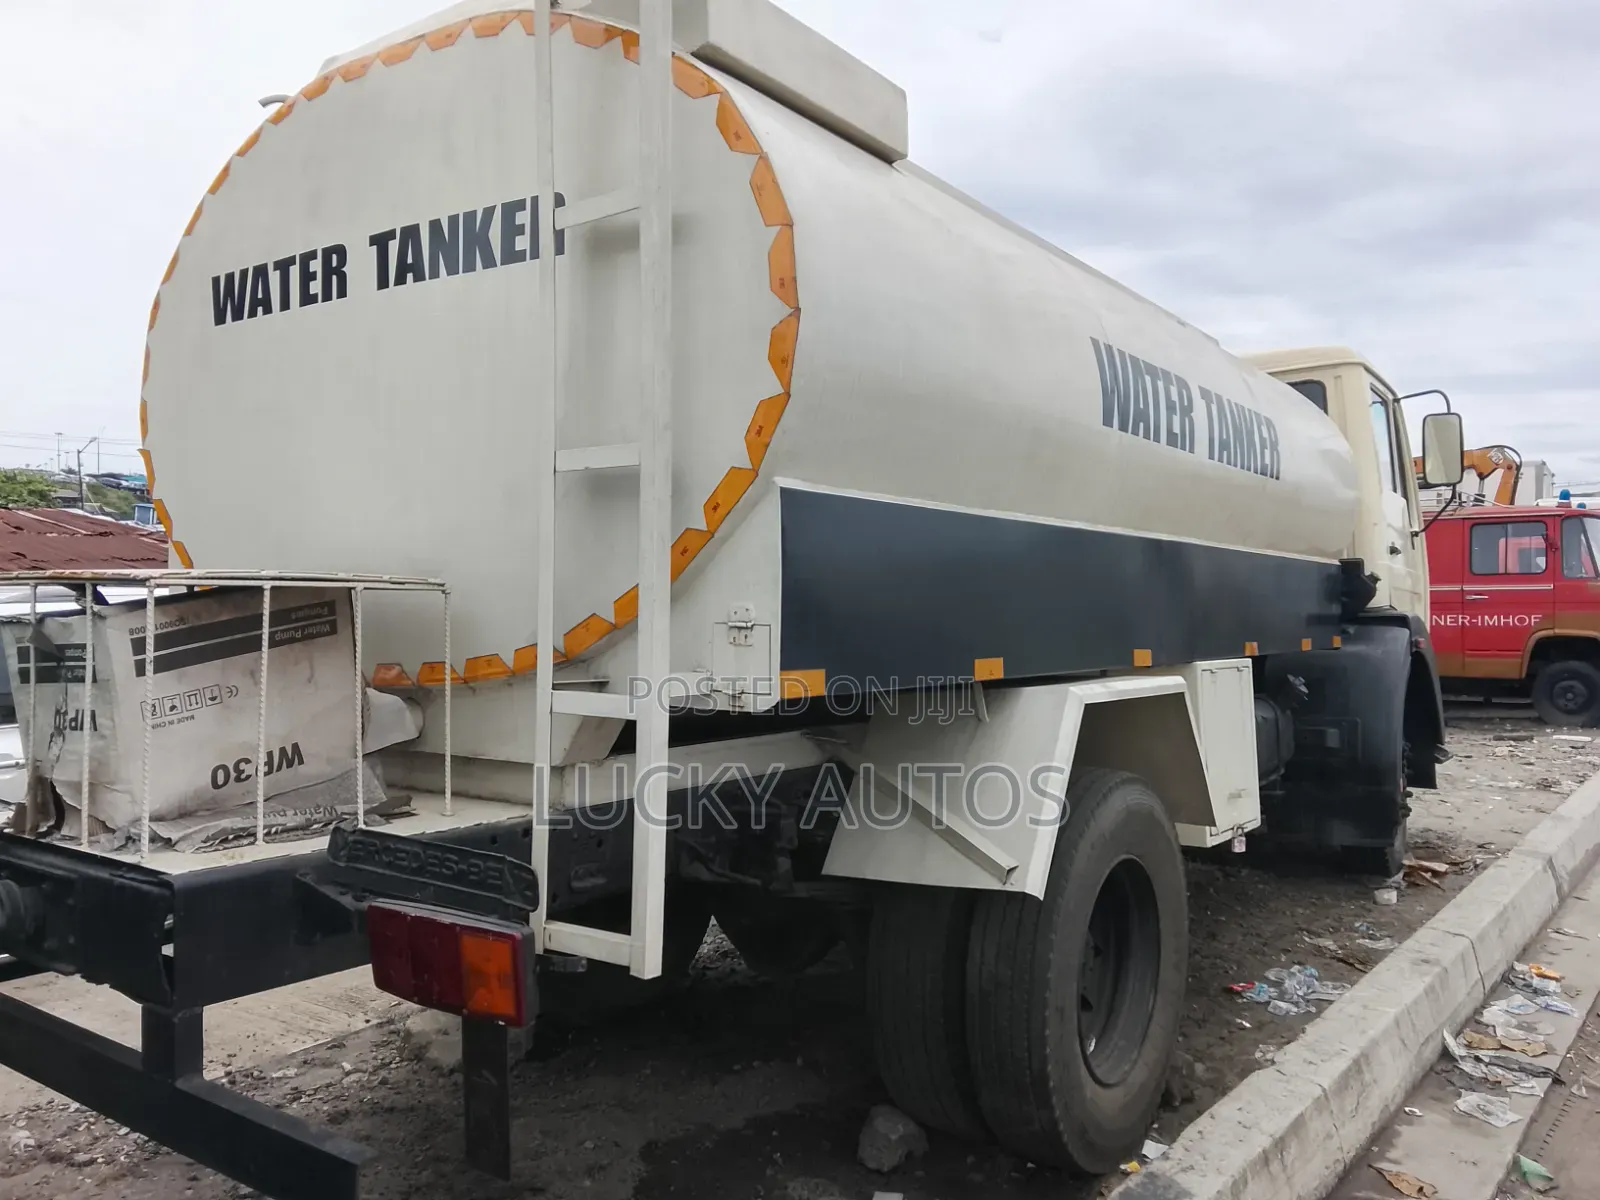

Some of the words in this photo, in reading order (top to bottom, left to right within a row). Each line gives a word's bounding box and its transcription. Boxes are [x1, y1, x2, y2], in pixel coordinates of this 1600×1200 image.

[211, 243, 348, 327] WATER
[1089, 336, 1195, 454] WATER
[1198, 384, 1281, 481] TANKER
[1432, 614, 1543, 627] NER-IMHOF
[274, 629, 302, 641] Pump
[303, 623, 331, 635] Water
[168, 719, 176, 727] IN
[178, 714, 195, 724] MADE
[151, 721, 167, 730] CHIN
[211, 742, 305, 790] WP30
[340, 834, 534, 897] ERCEDES-BE
